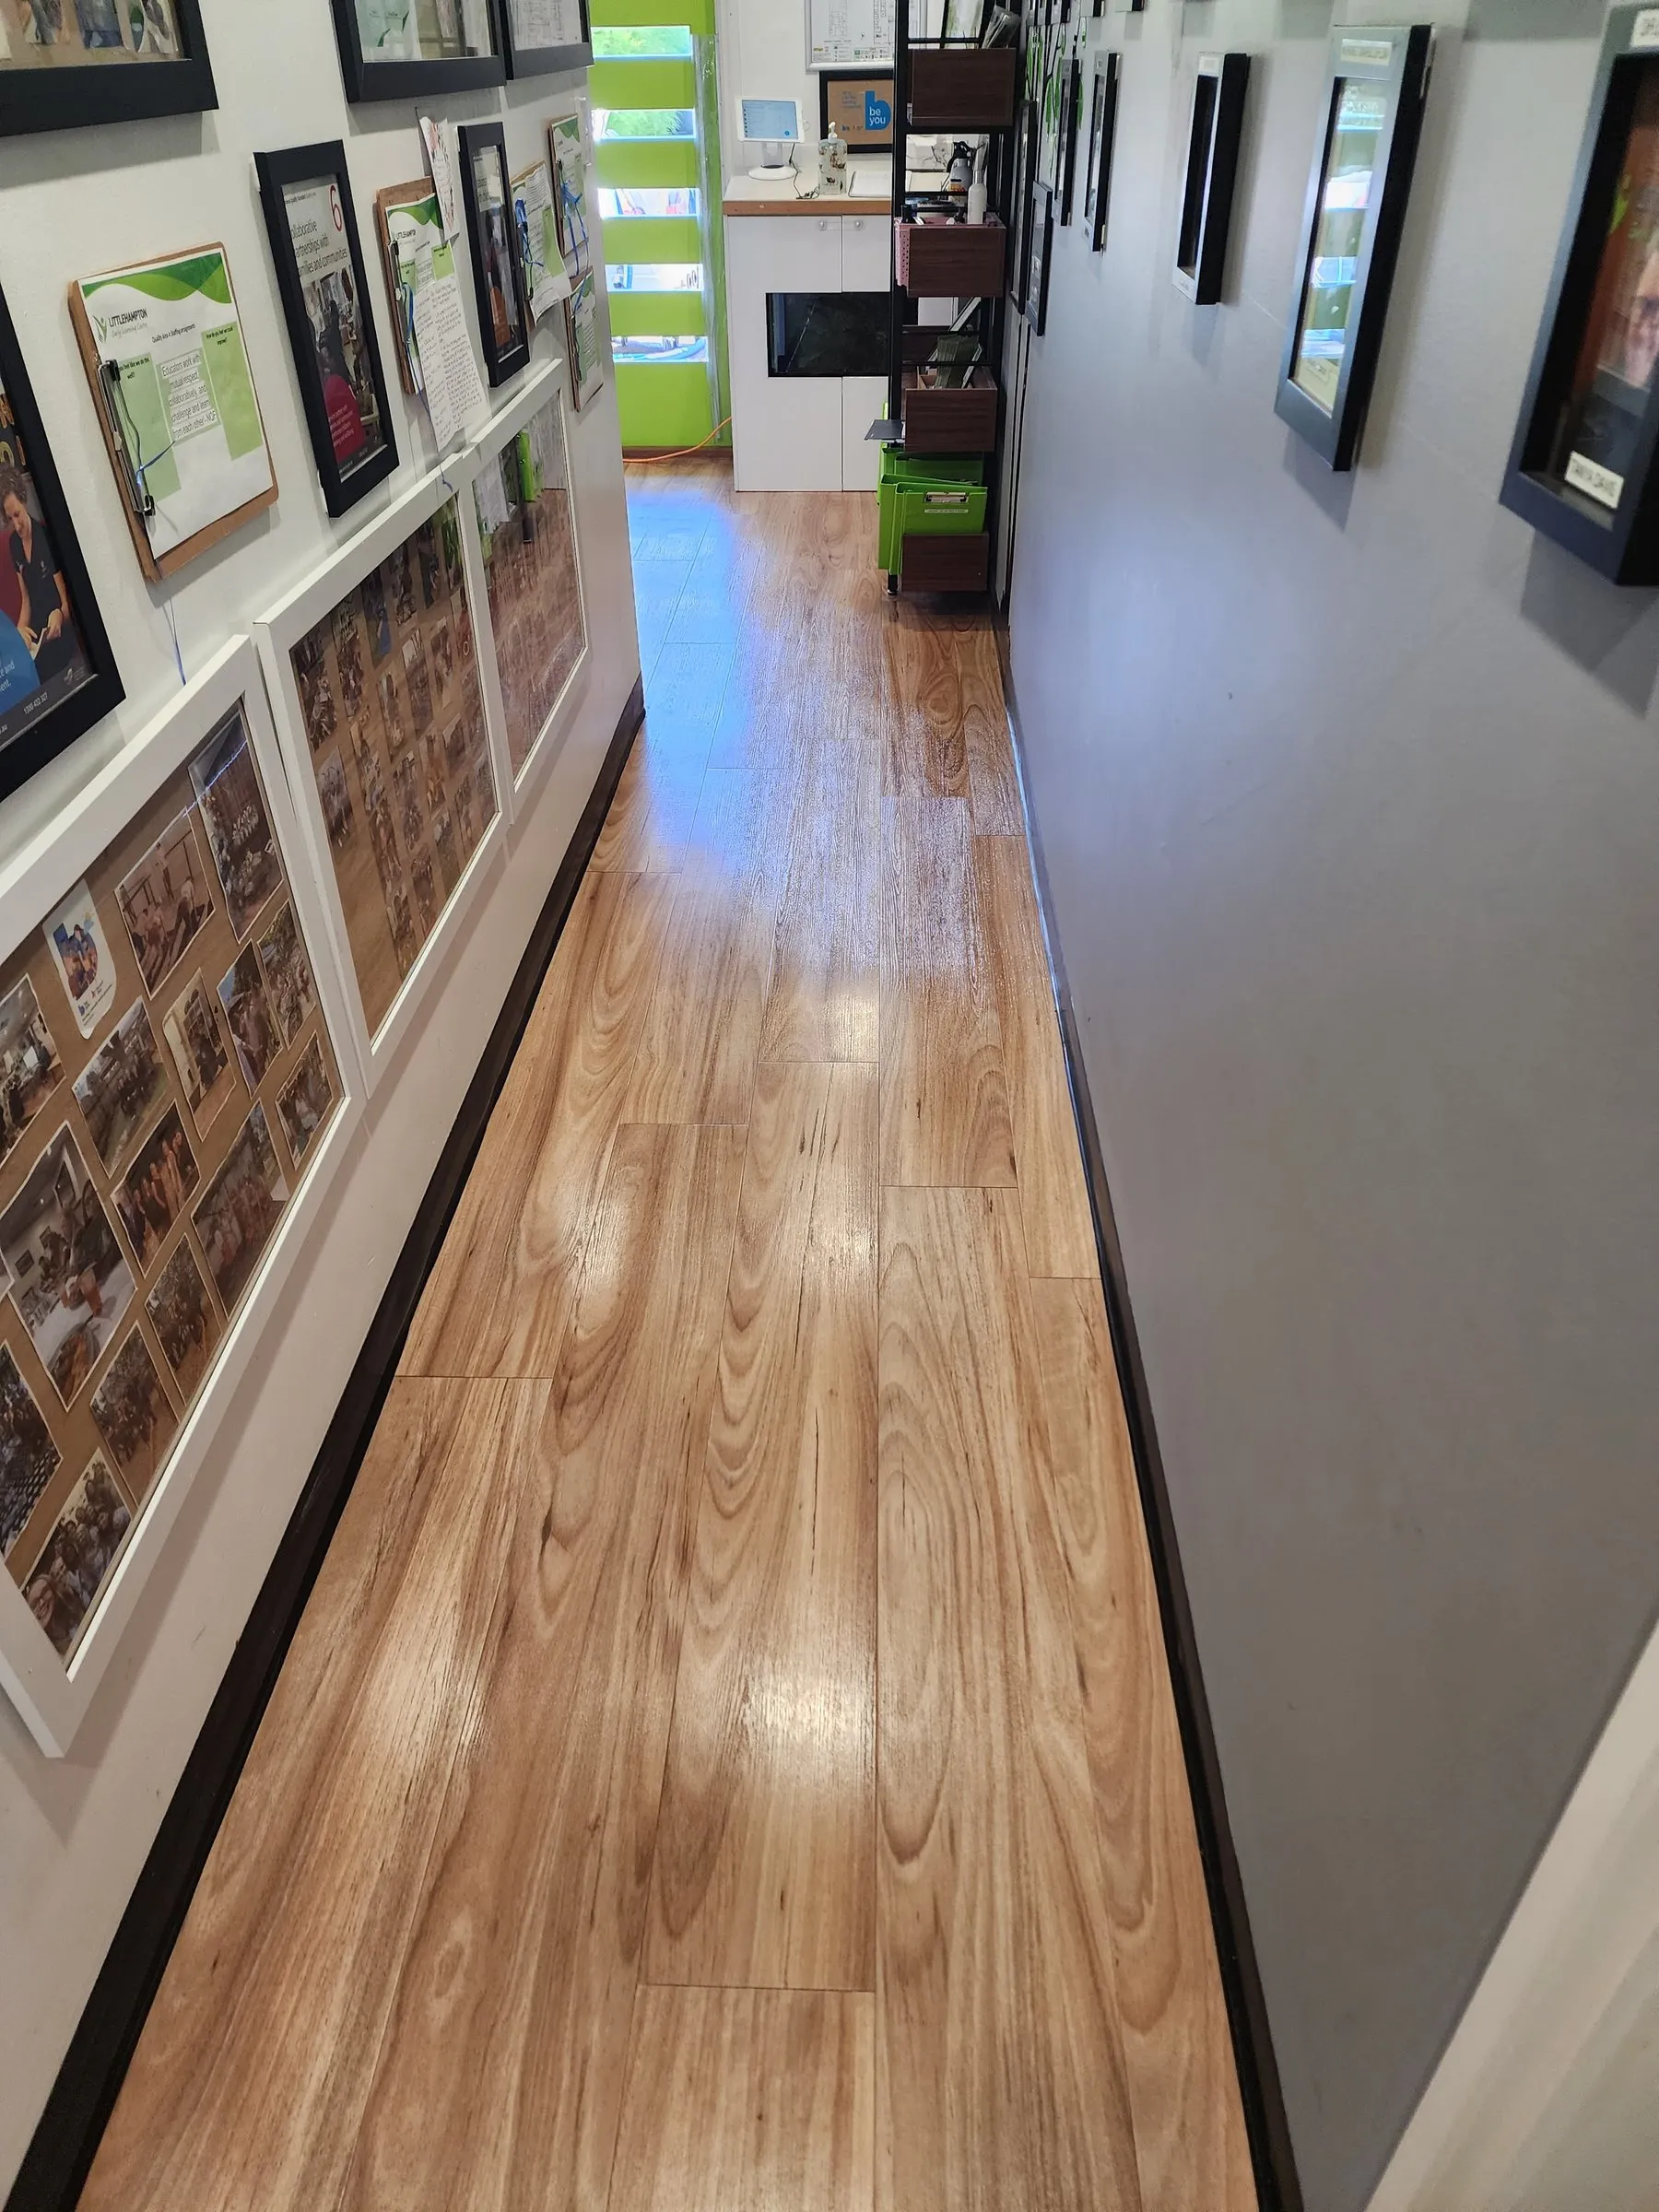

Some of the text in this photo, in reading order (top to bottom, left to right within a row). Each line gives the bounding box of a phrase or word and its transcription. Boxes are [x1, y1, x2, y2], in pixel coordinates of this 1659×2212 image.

[870, 106, 881, 116] be
[870, 117, 886, 126] you
[330, 185, 342, 231] 6
[109, 308, 147, 327] LITTLEHAMPTON
[183, 357, 192, 369] work
[171, 399, 210, 422] challenge and learn
[182, 423, 193, 434] each
[5, 659, 16, 675] and
